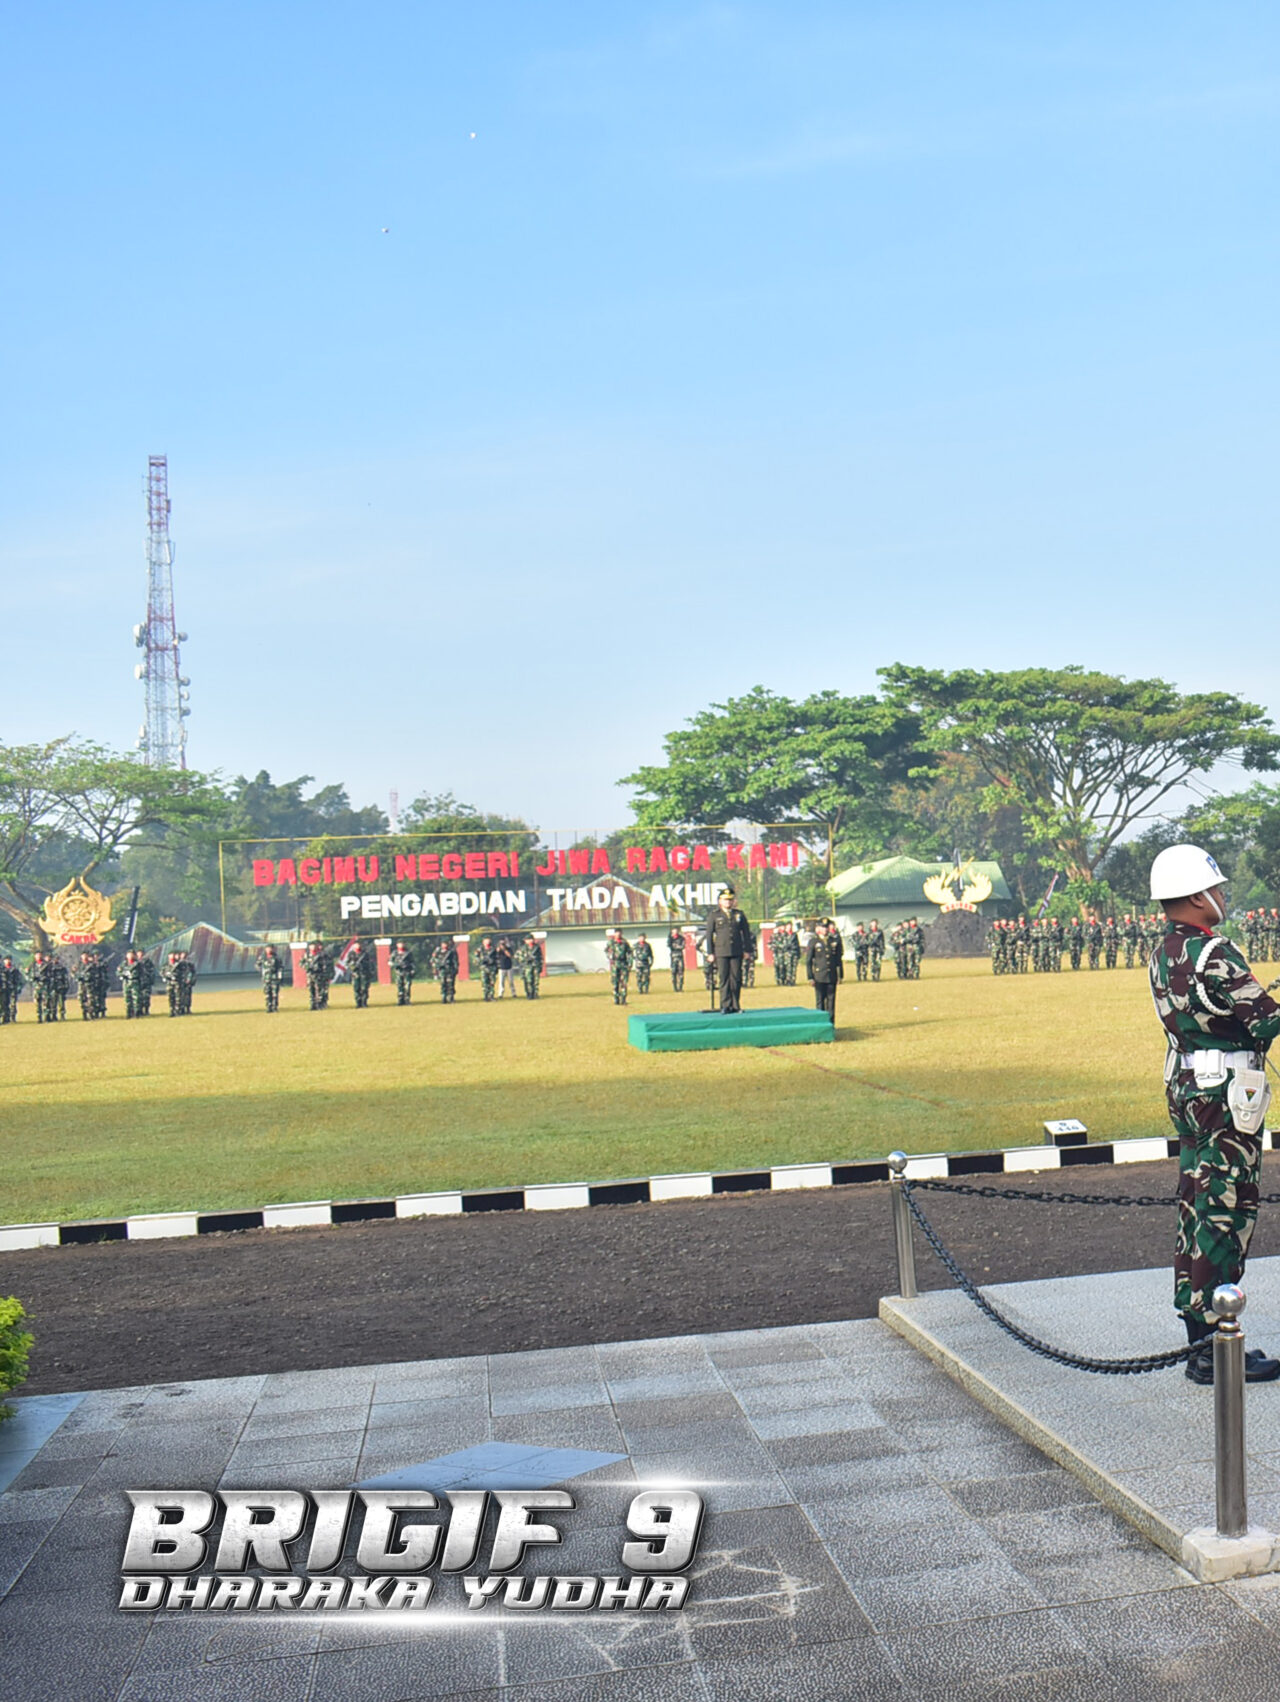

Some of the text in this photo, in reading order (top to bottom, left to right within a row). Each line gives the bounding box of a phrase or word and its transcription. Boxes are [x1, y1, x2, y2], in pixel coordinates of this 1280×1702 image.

[395, 851, 519, 882] NEGERI
[535, 847, 611, 877] JIWA
[625, 844, 712, 874] RAGA
[725, 841, 799, 871] KAMI
[340, 889, 526, 919] PENGABDIAN
[546, 886, 630, 911] TIADA
